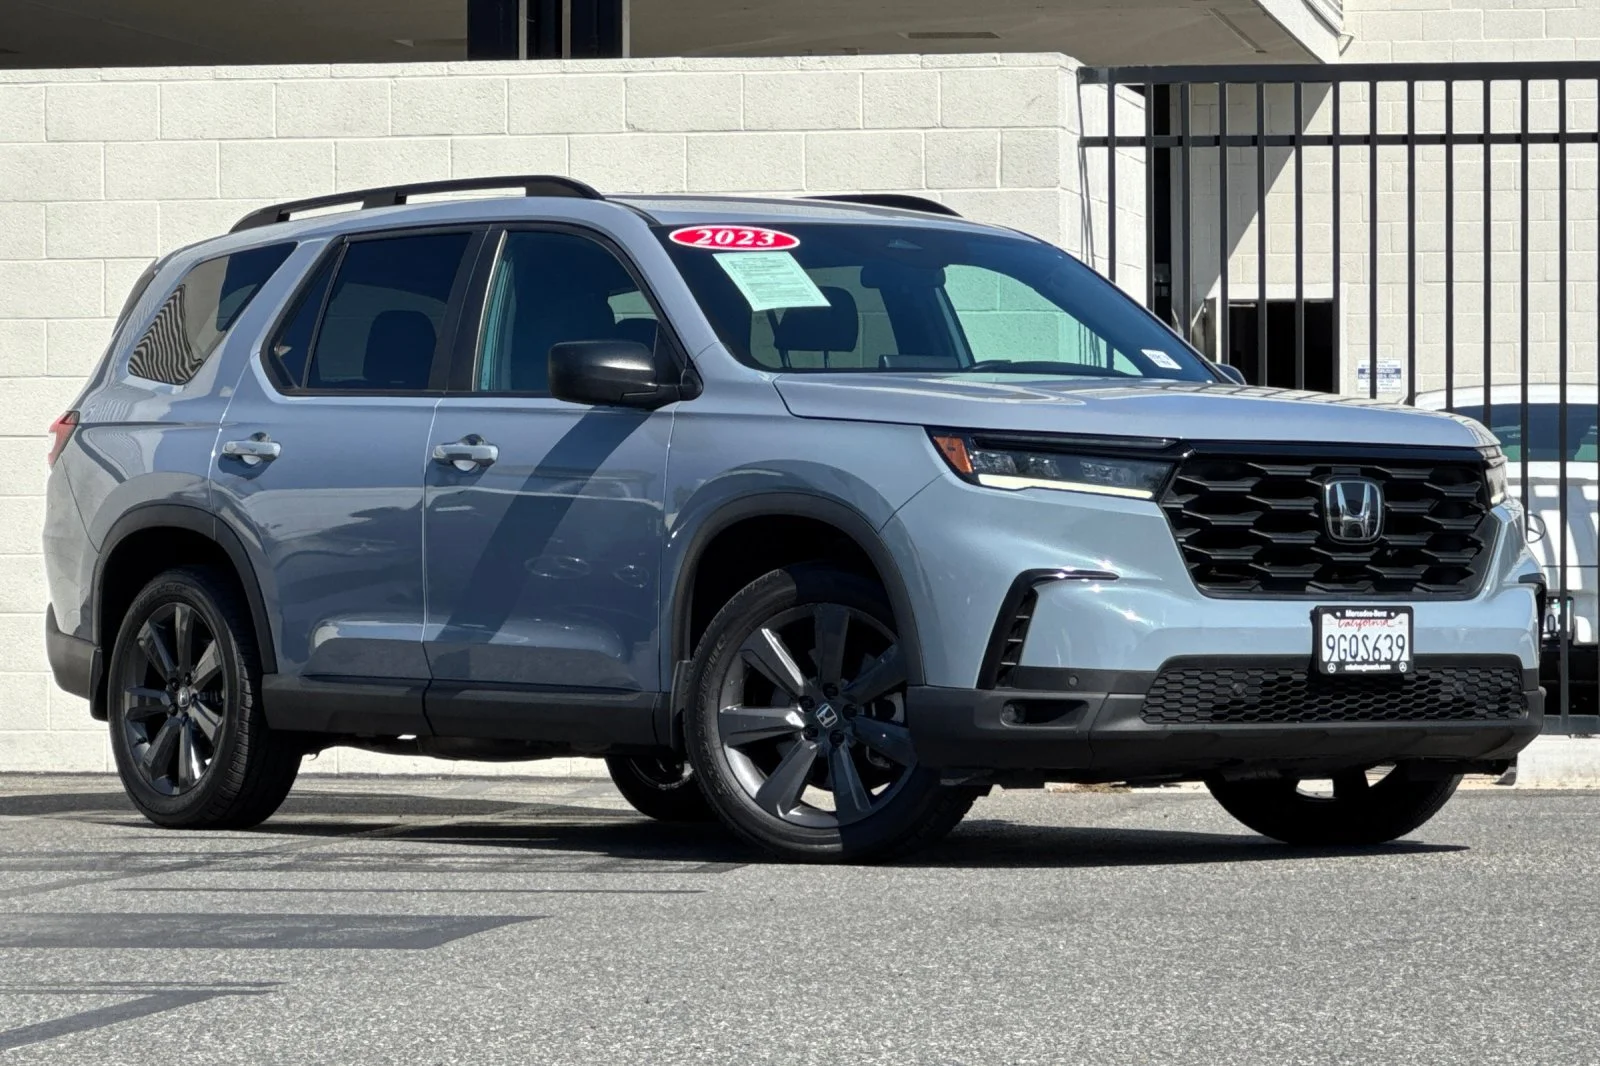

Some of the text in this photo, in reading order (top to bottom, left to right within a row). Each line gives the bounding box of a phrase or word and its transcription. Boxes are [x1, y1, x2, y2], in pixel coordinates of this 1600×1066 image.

[695, 229, 776, 246] 2023
[1338, 619, 1394, 632] California
[1326, 634, 1405, 662] 9GQS639
